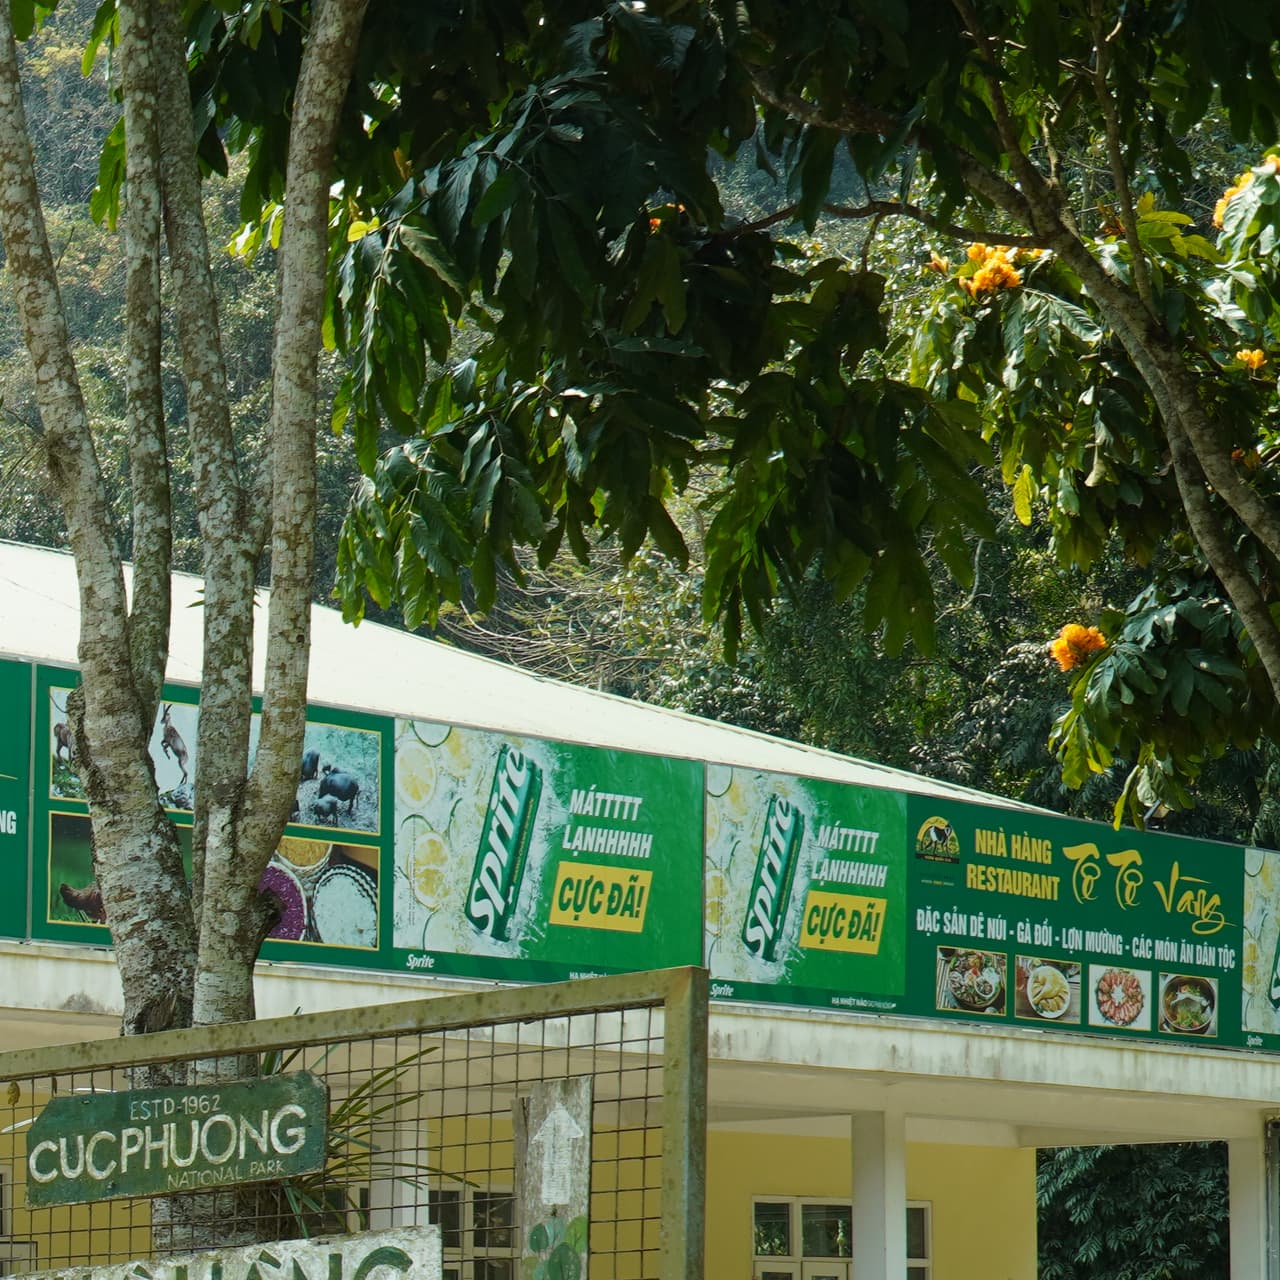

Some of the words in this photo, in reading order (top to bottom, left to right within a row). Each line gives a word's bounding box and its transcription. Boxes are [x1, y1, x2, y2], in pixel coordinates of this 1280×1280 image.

[569, 783, 643, 822] MÁTTTTT
[470, 747, 527, 937] Sprite
[561, 823, 654, 859] LẠNHHHHH
[817, 819, 880, 855] MÁTTTTT
[975, 827, 1008, 858] NHÀ
[1011, 831, 1053, 865] HÀNG
[746, 796, 792, 960] Sprite
[810, 857, 888, 888] LẠNHHHHH
[966, 863, 1061, 901] RESTAURANT
[558, 874, 605, 922] CỰC
[606, 874, 646, 920] ĐÃ!
[807, 903, 846, 945] CỰC
[847, 902, 881, 943] ĐÃ!
[916, 905, 941, 937] ĐẶC
[943, 906, 967, 936] SẢN
[970, 911, 985, 938] DÊ
[987, 914, 1007, 941] NÚI
[1016, 918, 1032, 945] GÀ
[1062, 926, 1082, 954] LỢN
[1085, 927, 1123, 956] MƯỜNG
[1132, 933, 1153, 960] CÁC
[1154, 936, 1178, 962] MÓN
[1179, 939, 1196, 964] ĂN
[1196, 941, 1216, 967] DÂN
[1217, 943, 1236, 972] TỘC
[405, 953, 435, 970] Sprite
[709, 983, 735, 998] Sprite
[167, 1165, 243, 1191] NATIONAL
[249, 1159, 285, 1177] PARK
